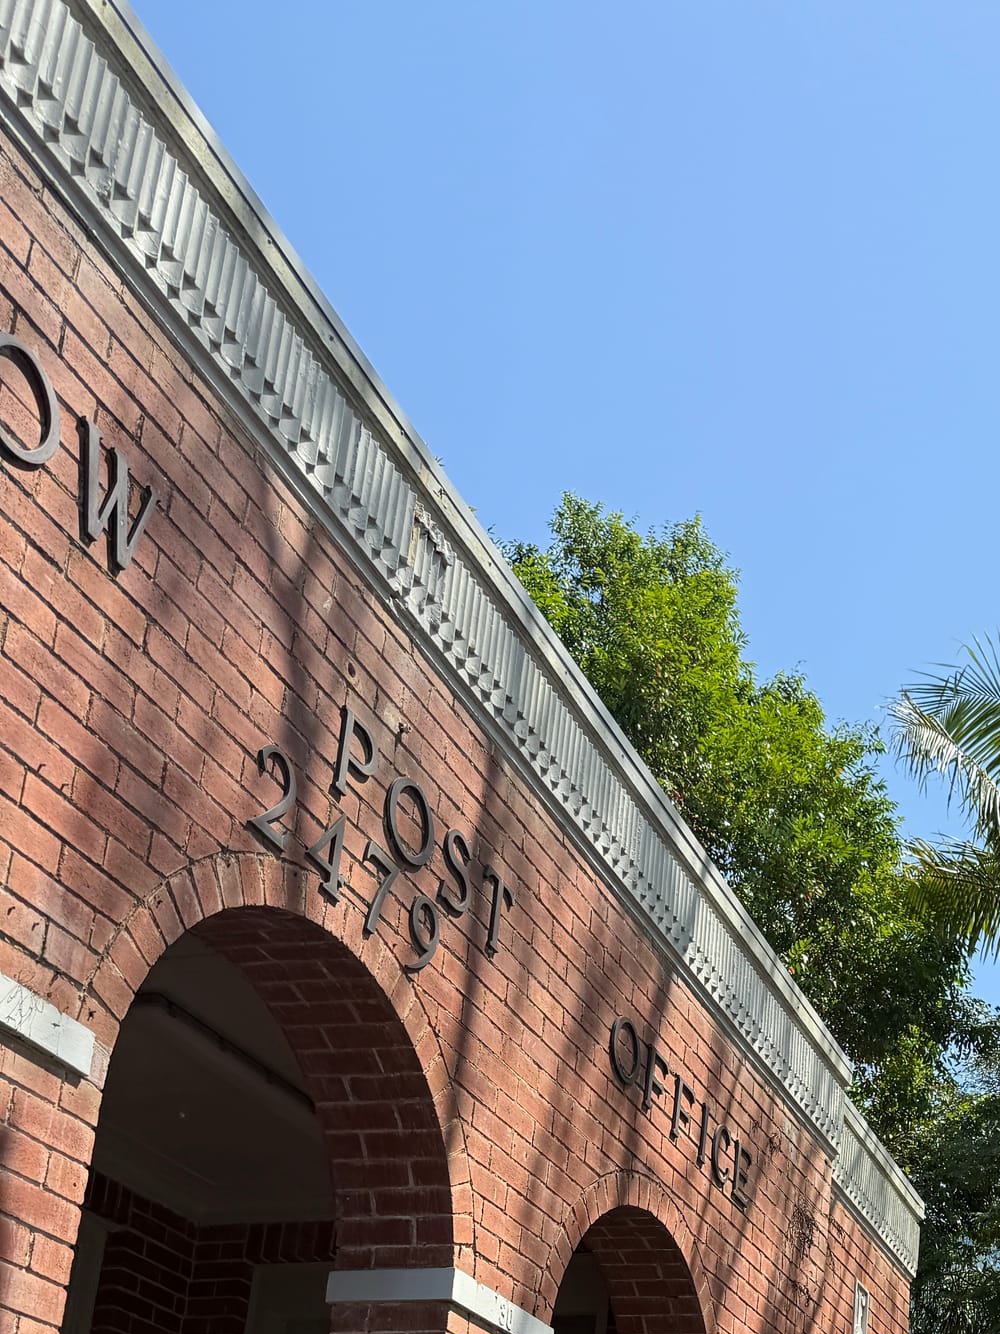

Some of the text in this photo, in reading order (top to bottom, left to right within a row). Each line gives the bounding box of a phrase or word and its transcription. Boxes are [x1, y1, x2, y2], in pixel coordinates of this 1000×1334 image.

[247, 744, 441, 973] 2479
[328, 704, 516, 960] POST
[608, 1015, 753, 1214] OFFICE
